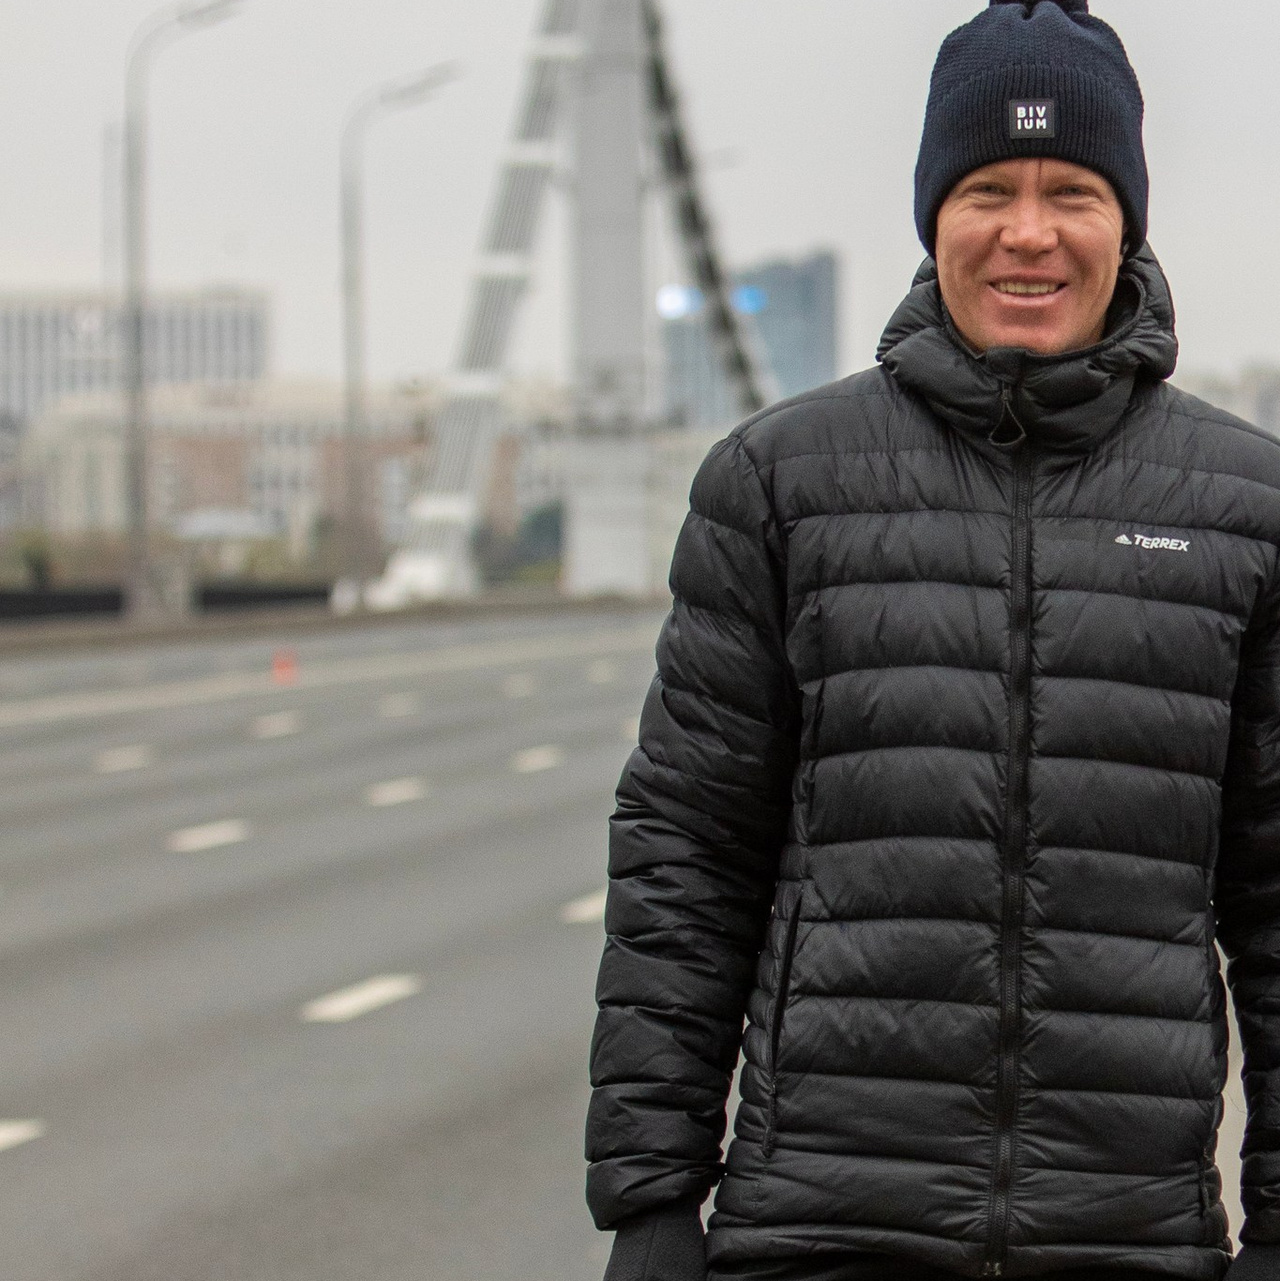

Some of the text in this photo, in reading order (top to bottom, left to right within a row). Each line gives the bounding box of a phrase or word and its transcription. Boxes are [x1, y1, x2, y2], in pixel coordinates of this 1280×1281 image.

[1016, 105, 1046, 118] BIV
[1017, 118, 1047, 130] IUM
[1134, 533, 1190, 552] TERREX
